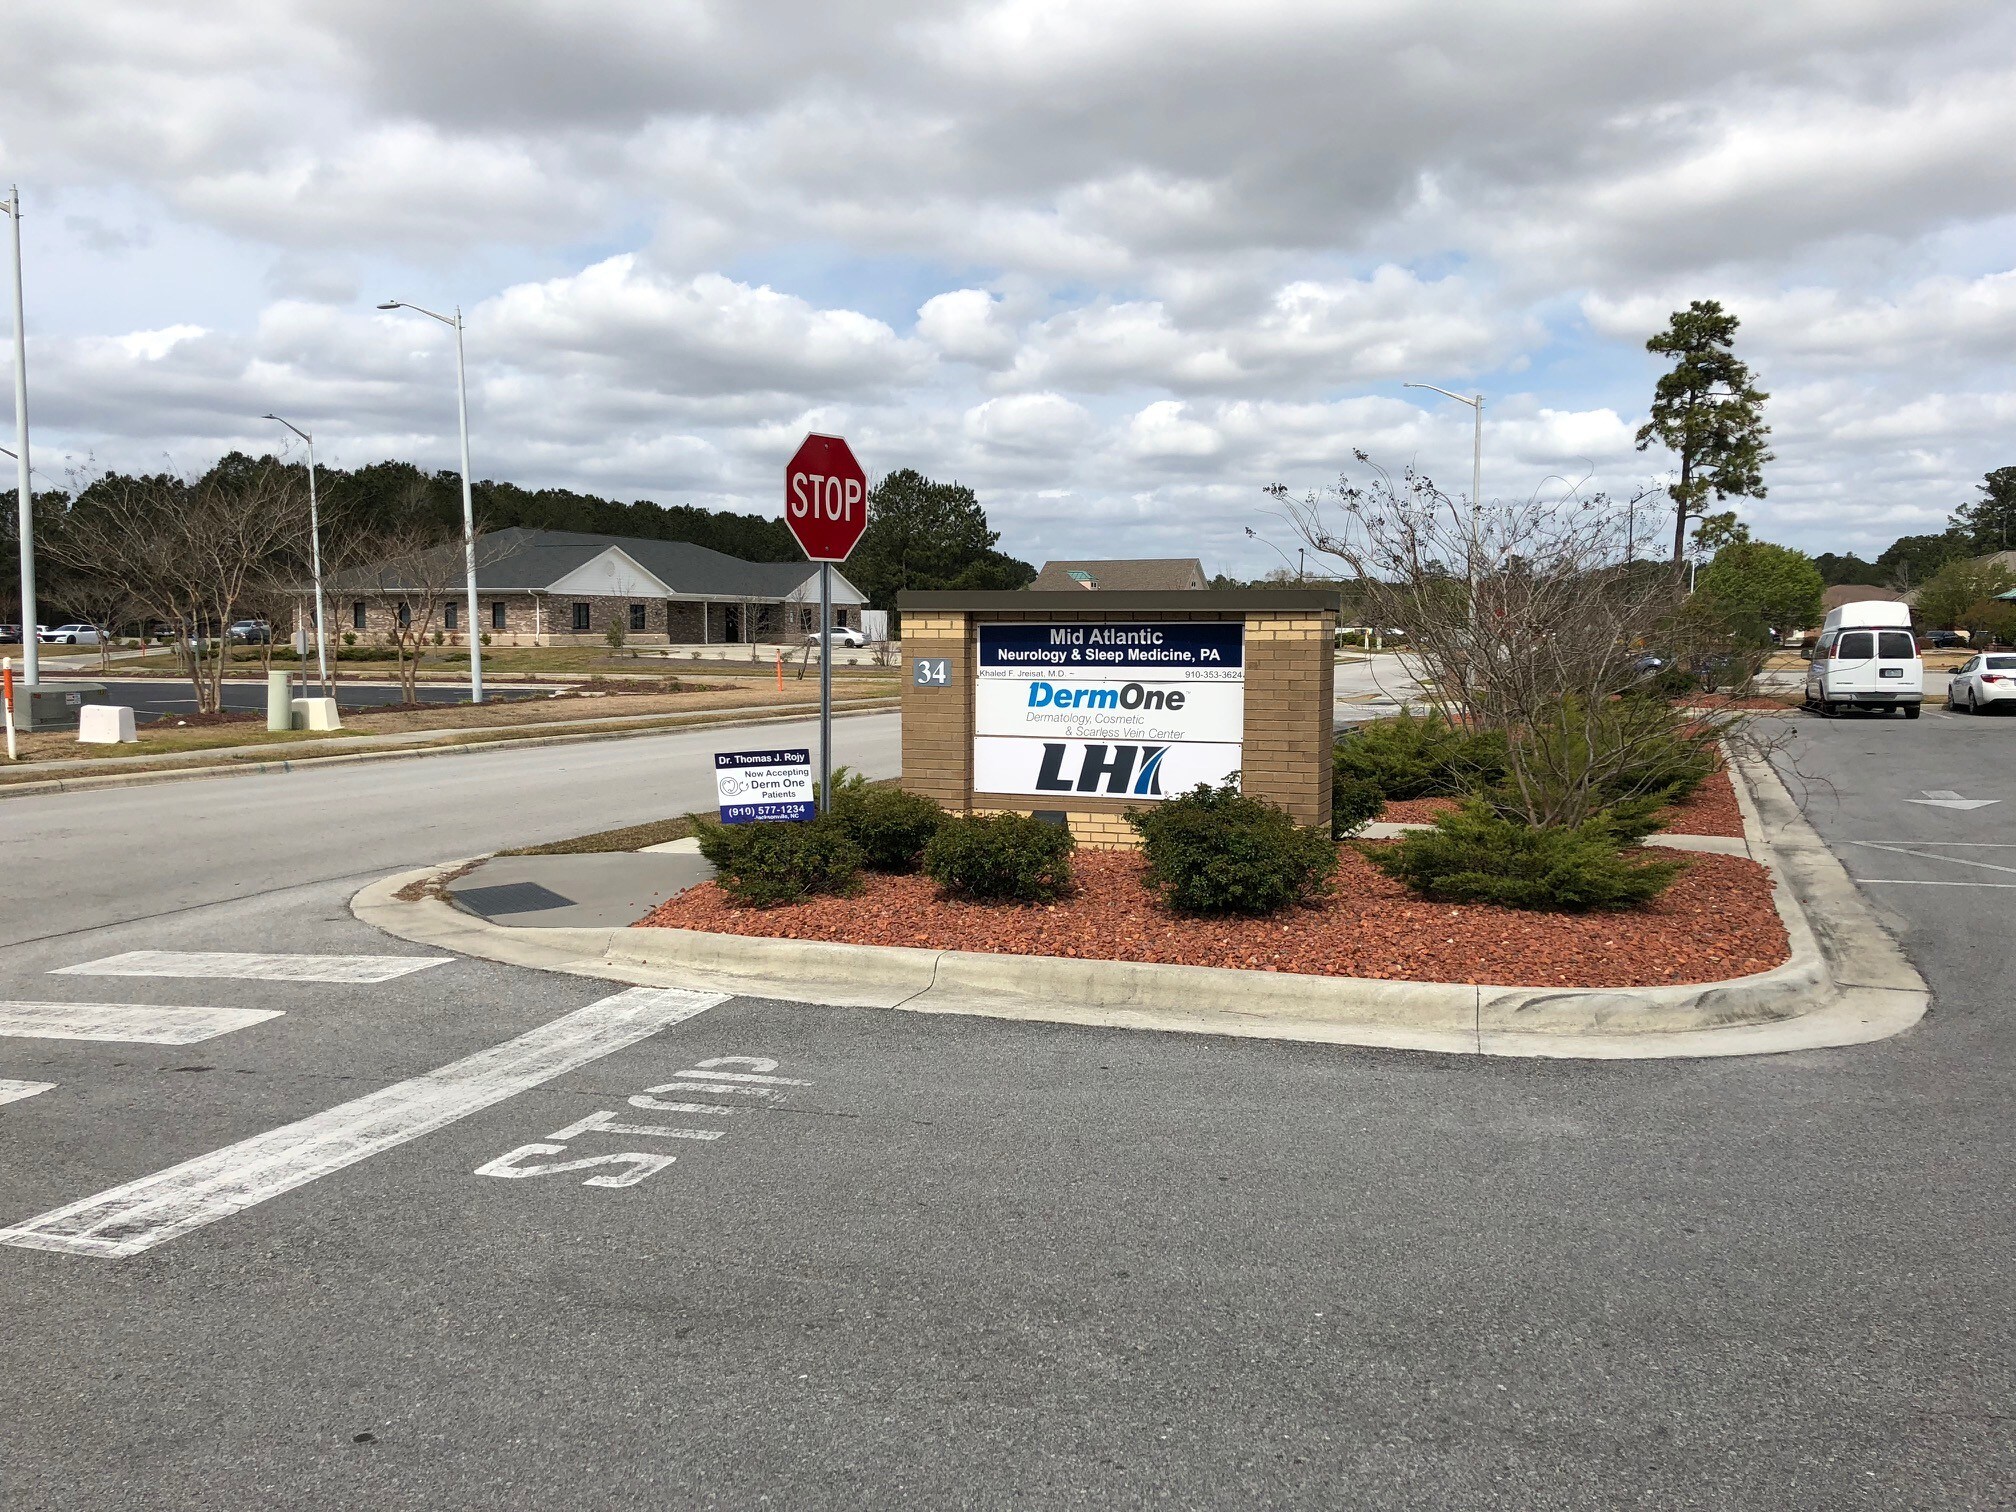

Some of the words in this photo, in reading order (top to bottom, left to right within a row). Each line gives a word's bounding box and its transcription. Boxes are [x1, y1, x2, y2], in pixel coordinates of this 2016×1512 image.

[791, 472, 862, 521] STOP
[1050, 628, 1083, 644] Mid
[1089, 628, 1163, 644] Atlantic
[998, 648, 1067, 663] Neurology
[1070, 649, 1081, 660] &
[1085, 648, 1124, 663] Sleep
[1128, 649, 1195, 662] Medicine,
[1201, 649, 1220, 661] PA
[917, 659, 946, 685] 34
[979, 669, 1006, 677] Khaled
[1017, 670, 1046, 678] Jreisat,
[1185, 670, 1242, 679] 910-353-3624
[1028, 682, 1186, 710] DermOne
[1026, 712, 1092, 725] Dermatology,
[1094, 713, 1145, 724] Cosmetic
[1065, 726, 1073, 736] &
[1076, 726, 1120, 738] Scarless
[1123, 728, 1145, 738] Vein
[1148, 728, 1185, 739] Center
[718, 756, 733, 765] Dr.
[733, 755, 772, 764] Thomas
[773, 754, 782, 762] J.
[784, 753, 805, 762] Rojy
[744, 770, 764, 778] Now
[766, 768, 809, 777] Accepting
[751, 780, 781, 789] Derm
[783, 779, 805, 787] One
[762, 790, 796, 798] Patients
[729, 806, 755, 818] (910)
[758, 804, 805, 815] 577-1234
